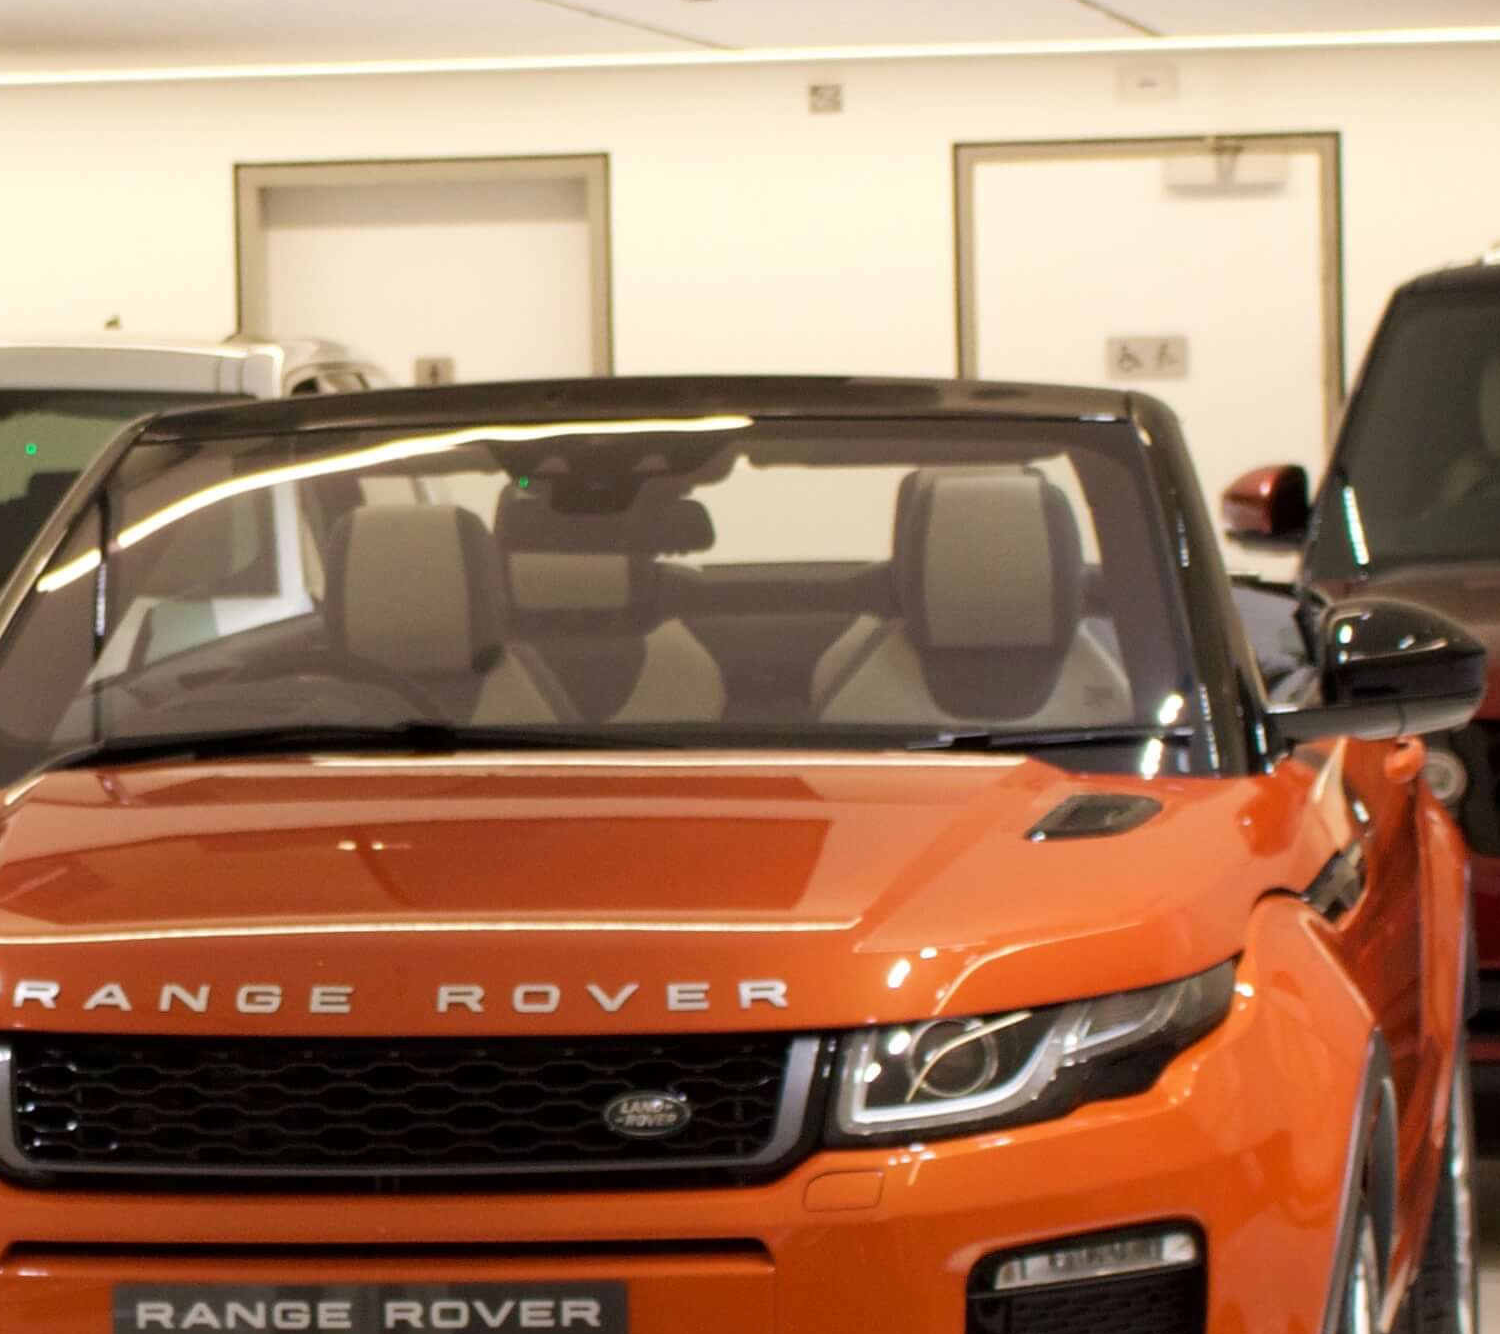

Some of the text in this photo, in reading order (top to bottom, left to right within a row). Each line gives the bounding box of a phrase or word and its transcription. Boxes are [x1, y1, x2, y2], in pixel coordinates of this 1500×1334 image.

[13, 979, 789, 1015] RANGE ROVER
[136, 1300, 602, 1330] RANGE ROVER
